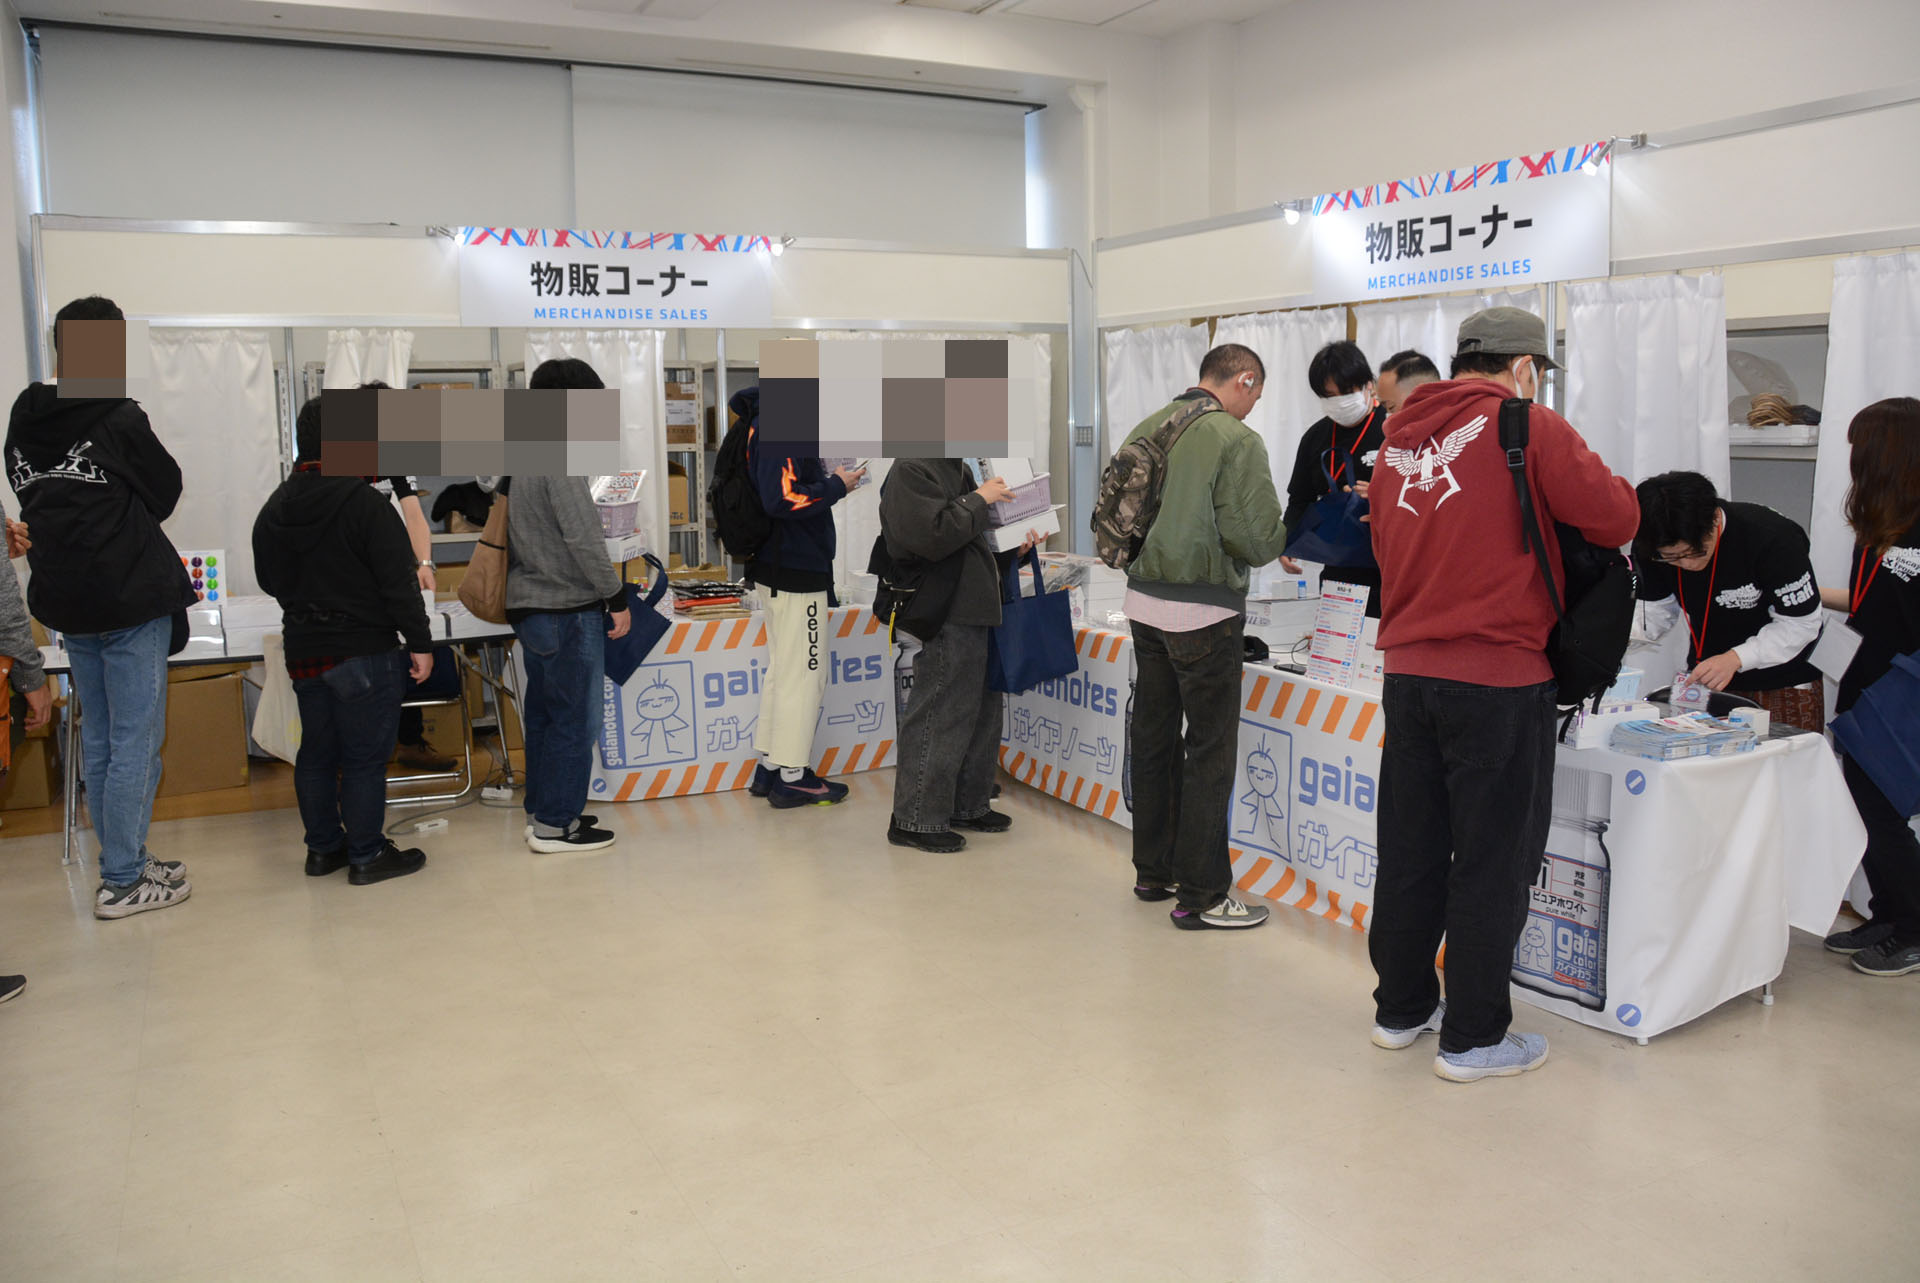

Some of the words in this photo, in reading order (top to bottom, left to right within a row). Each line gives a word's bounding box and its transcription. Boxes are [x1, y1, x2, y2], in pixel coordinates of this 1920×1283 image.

[1365, 204, 1533, 264] 物販コーナー
[530, 260, 709, 298] 物販コーナー
[1367, 266, 1475, 290] MERCHANDISE
[1480, 259, 1532, 278] SALES
[533, 307, 655, 320] MERCHANDISE
[659, 309, 708, 320] SALES
[806, 601, 819, 671] deuce
[703, 650, 882, 708] gaites
[1014, 707, 1118, 775] ガイアノーツ
[1532, 889, 1588, 915] ピュアホワイト
[1556, 926, 1597, 961] gaia
